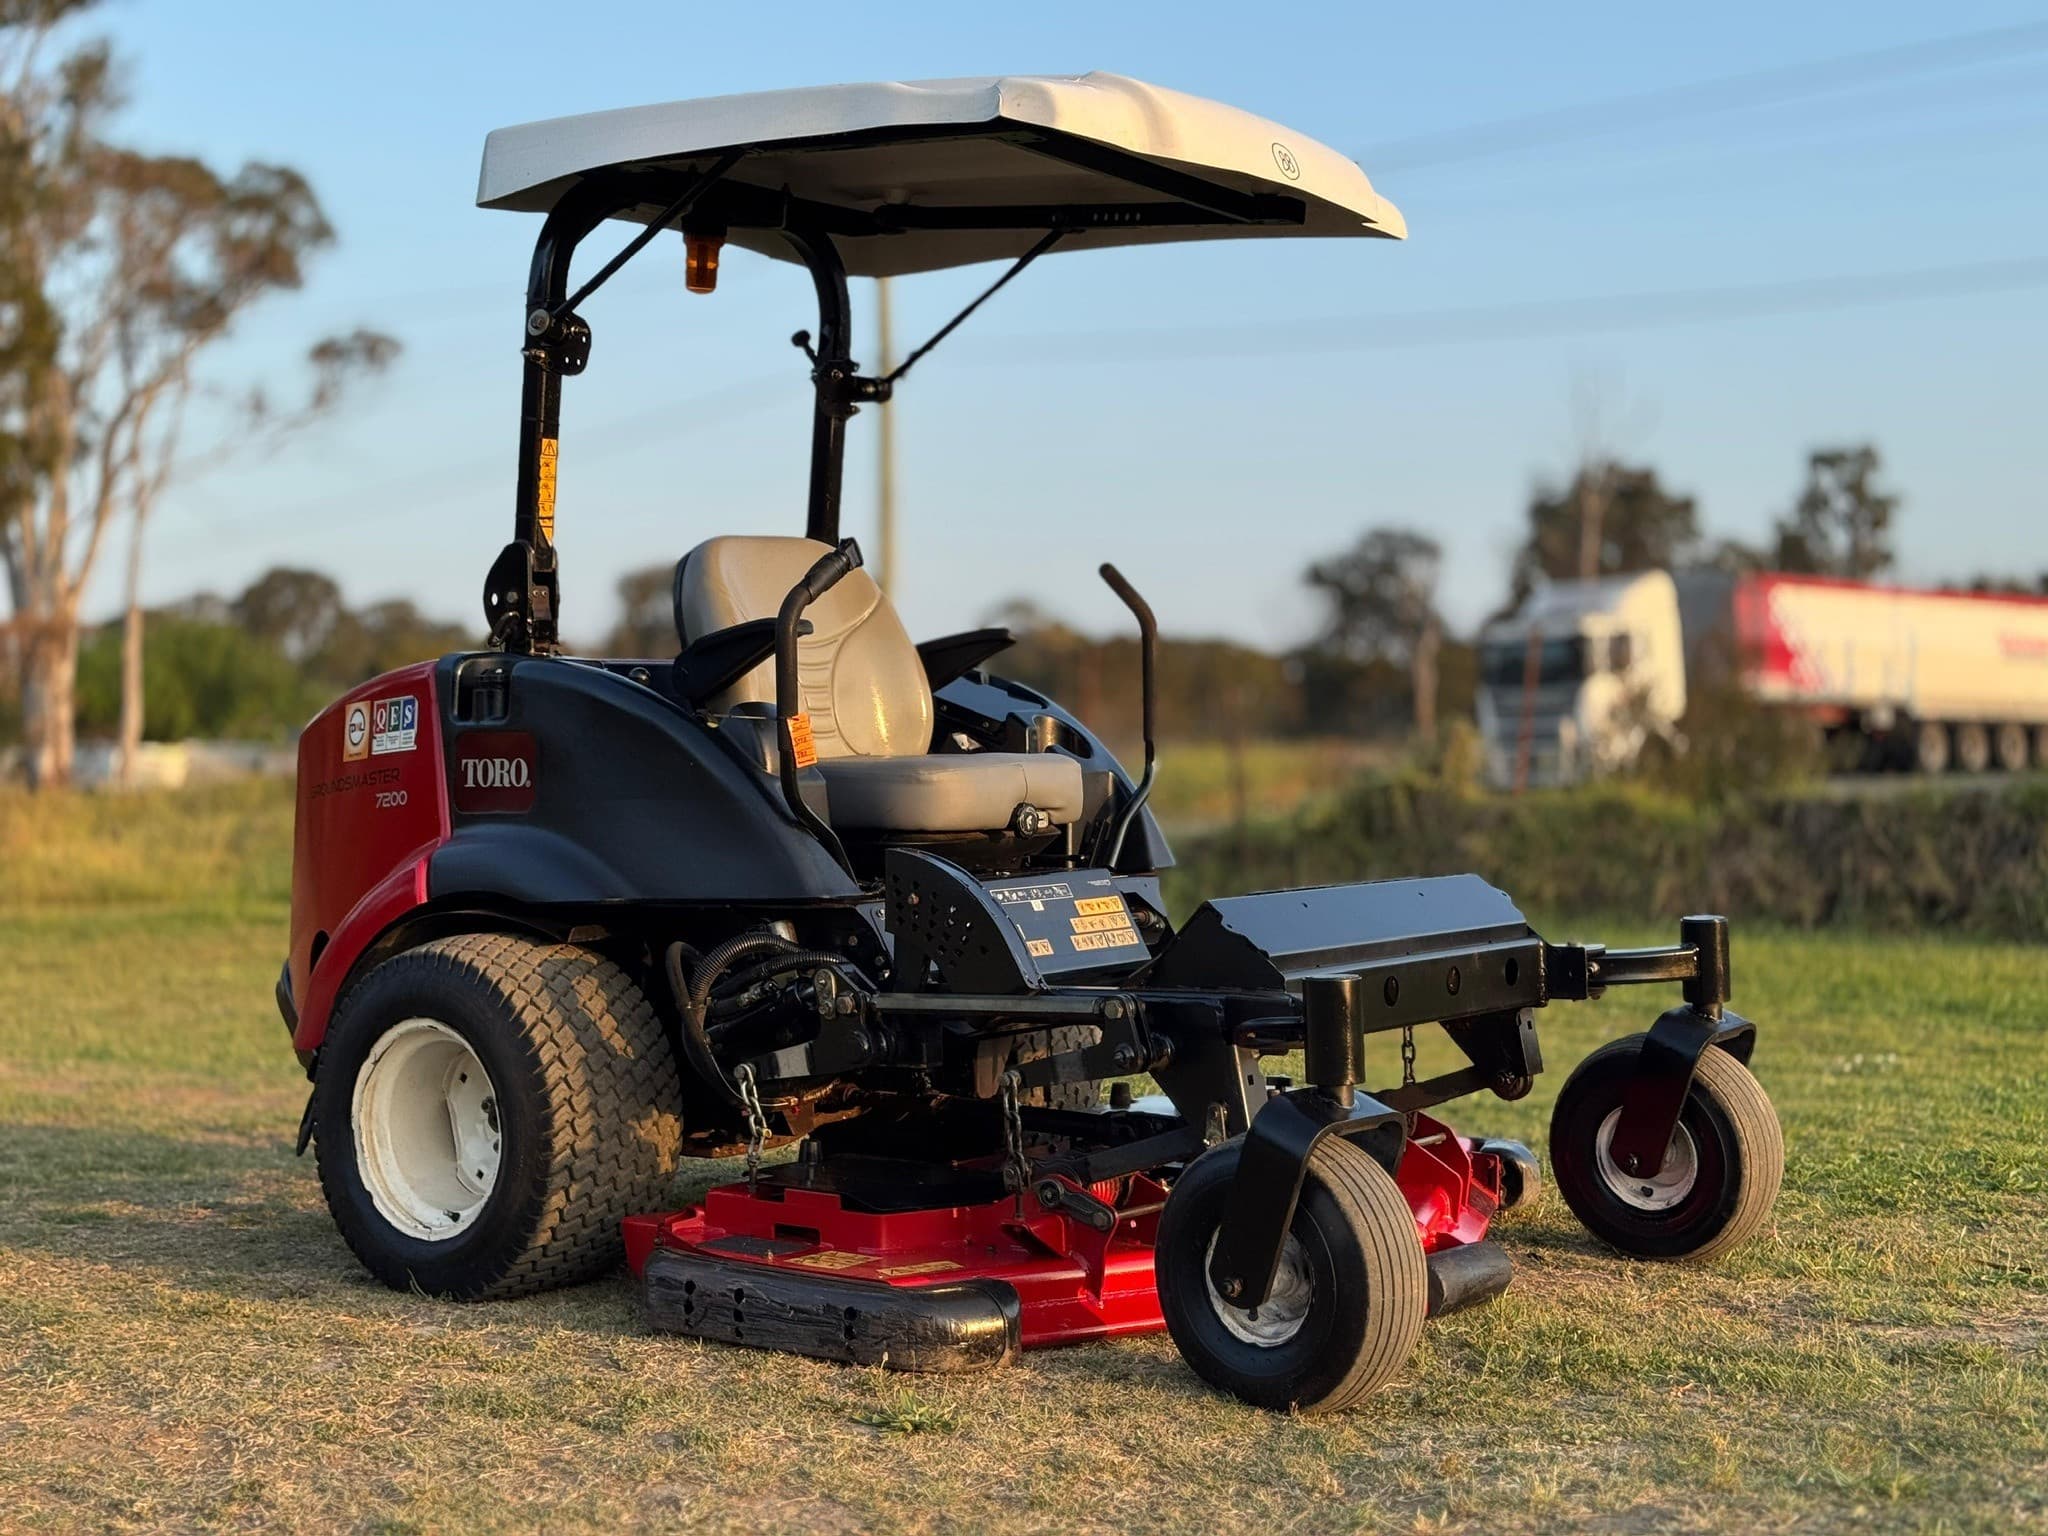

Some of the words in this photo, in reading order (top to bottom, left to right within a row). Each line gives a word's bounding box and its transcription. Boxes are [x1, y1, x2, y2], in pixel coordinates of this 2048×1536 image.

[306, 767, 400, 800] RONDSMASTER
[461, 758, 528, 788] TORO
[375, 790, 408, 808] 7200
